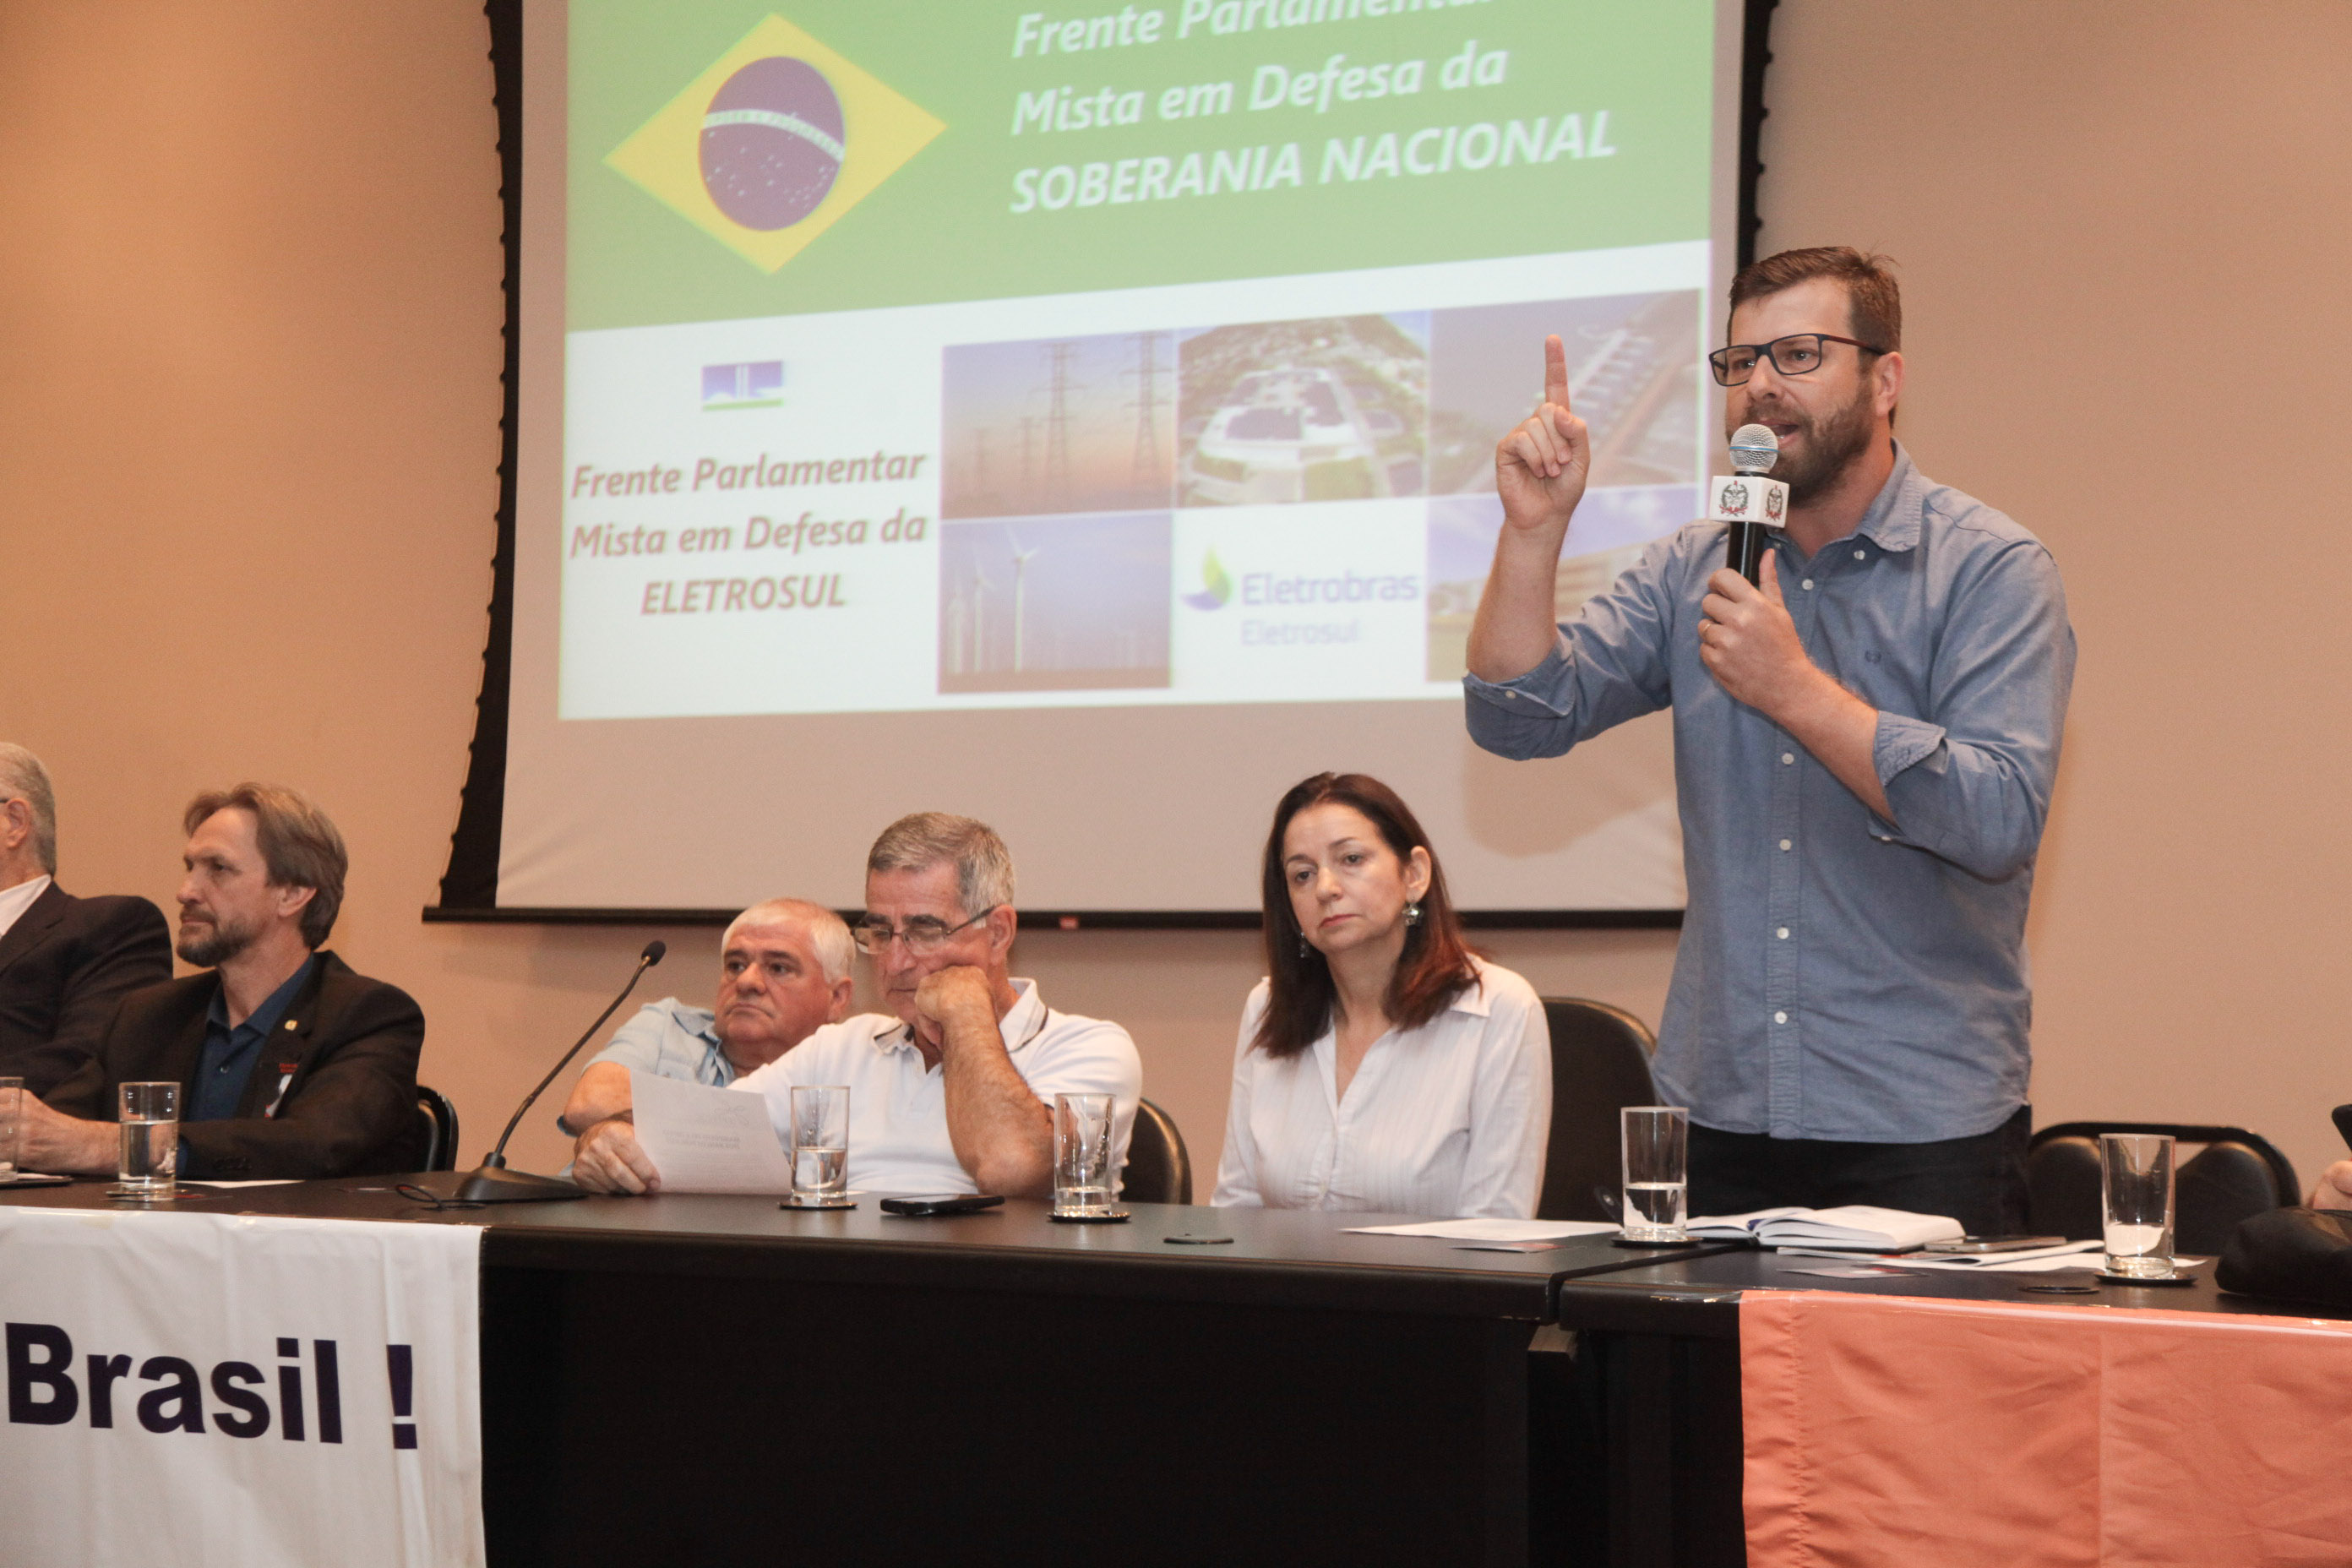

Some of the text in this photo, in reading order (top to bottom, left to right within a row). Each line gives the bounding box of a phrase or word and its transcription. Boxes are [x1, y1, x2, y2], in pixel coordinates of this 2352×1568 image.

[1014, 0, 1492, 57] Frente Parlame
[1012, 40, 1509, 135] Mista em Defesa da
[1010, 110, 1617, 215] SOBERANIA NACIONAL
[571, 450, 926, 498] Frente Parlamentar
[569, 508, 927, 558] Mista em Defesa da
[640, 574, 846, 616] ELETROSUL
[1242, 569, 1418, 606] Eletrobras
[1241, 619, 1358, 646] Eletrosul
[5, 1321, 417, 1450] Brasil !
